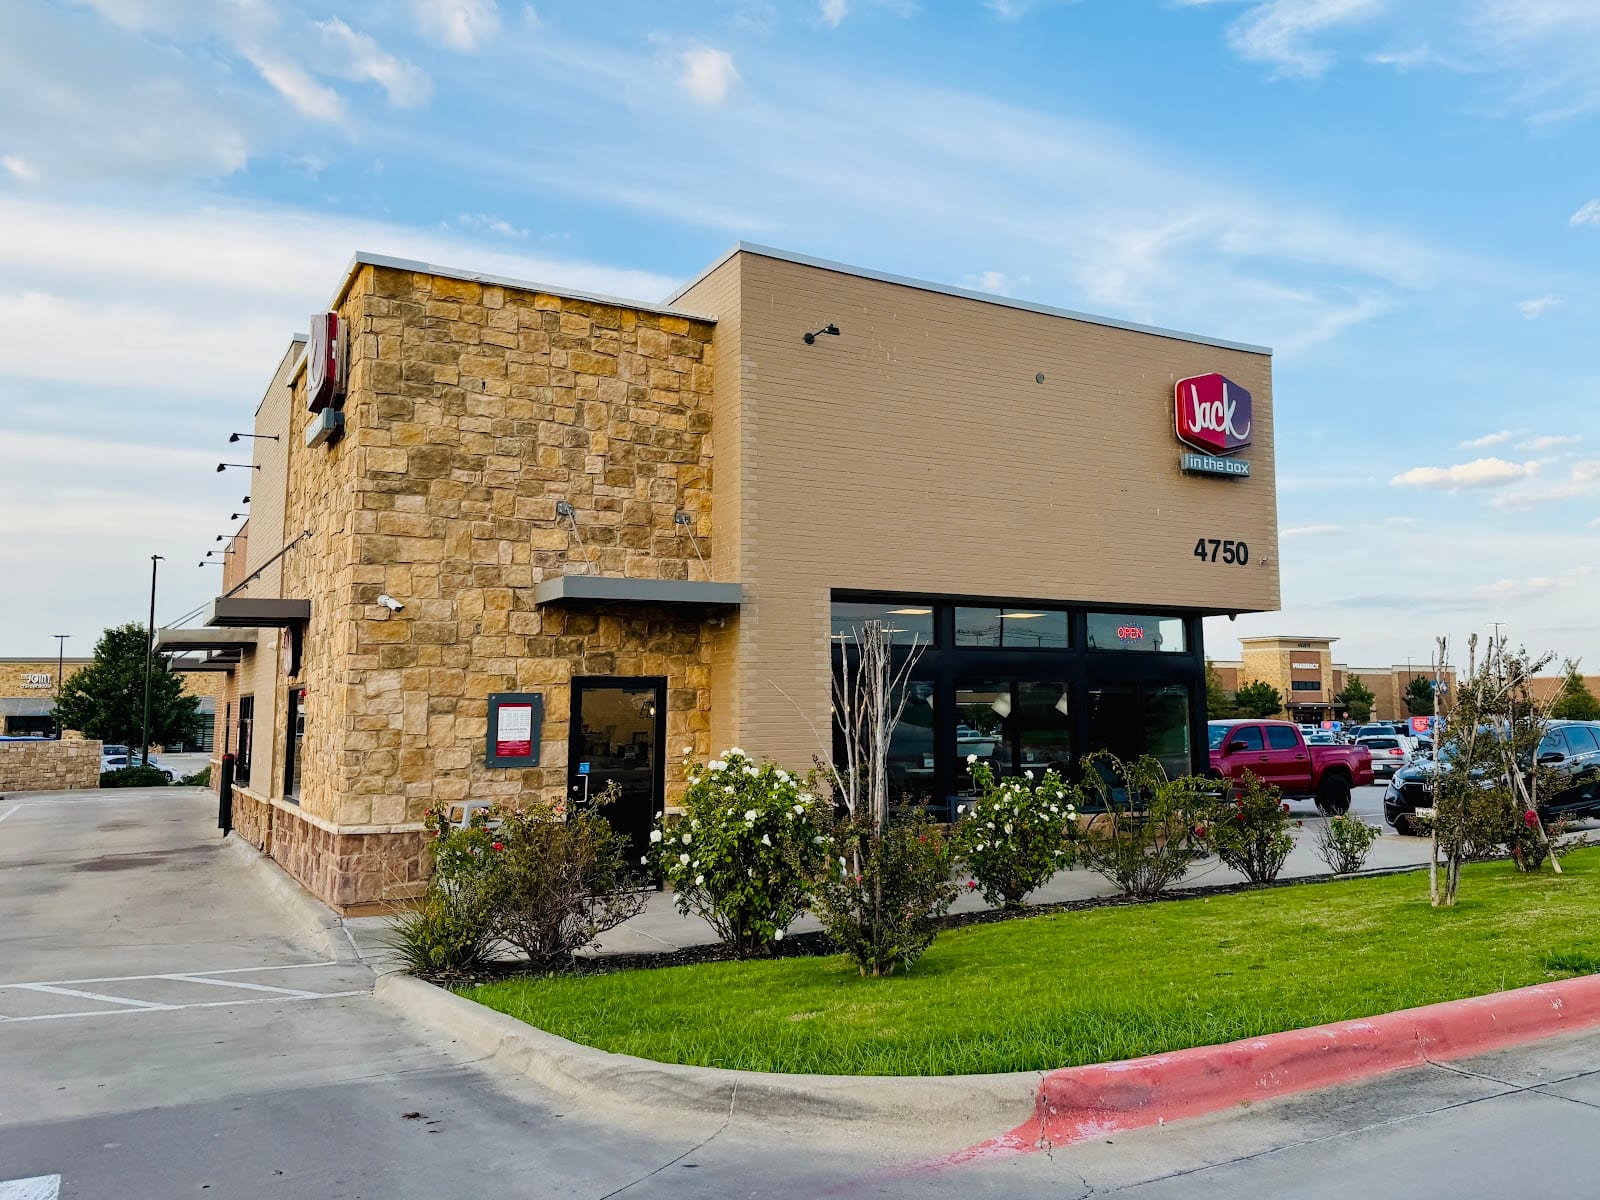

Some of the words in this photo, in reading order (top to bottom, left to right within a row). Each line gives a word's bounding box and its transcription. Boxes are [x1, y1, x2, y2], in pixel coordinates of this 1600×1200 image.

[1188, 382, 1251, 440] Jack
[1190, 455, 1202, 468] in
[1203, 457, 1224, 471] the
[1226, 460, 1250, 474] box
[1193, 538, 1249, 566] 4750
[1117, 626, 1144, 639] OPEN
